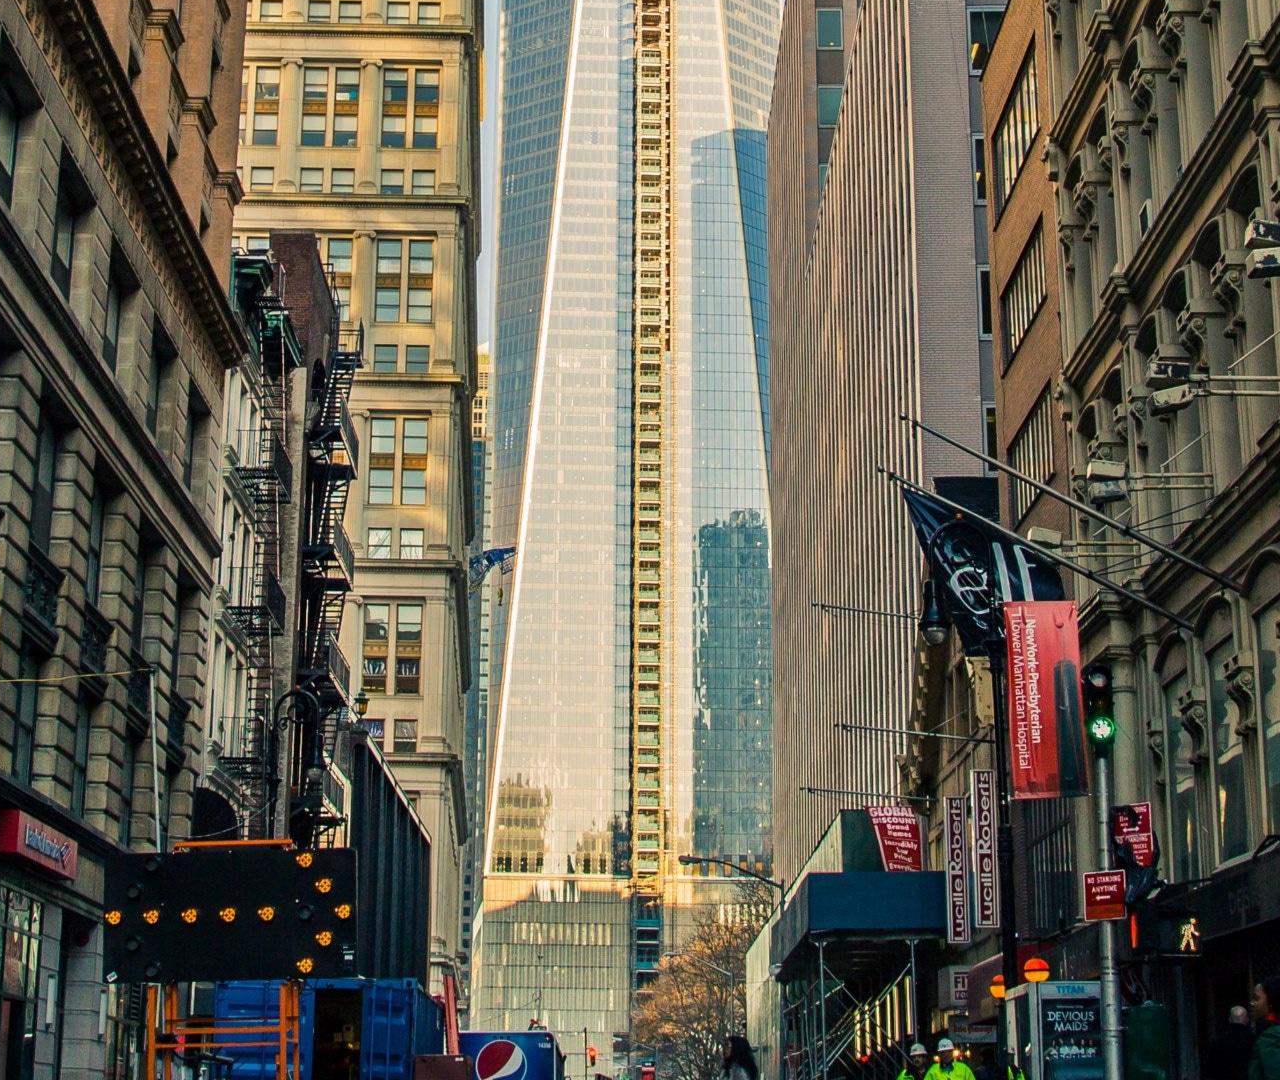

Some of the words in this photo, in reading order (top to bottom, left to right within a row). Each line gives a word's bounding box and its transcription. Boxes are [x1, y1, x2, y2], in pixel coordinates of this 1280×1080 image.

[1011, 620, 1021, 649] Lower
[1013, 653, 1027, 720] Manhattan
[1025, 619, 1041, 745] NewYork-Presbyterian
[1016, 721, 1032, 769] Hospital
[869, 806, 915, 818] GLOBAL
[872, 816, 916, 825] DISCOUNT
[976, 772, 991, 854] Roberts
[949, 799, 963, 875] Roberts
[980, 856, 993, 925] Lucille
[1087, 877, 1095, 885] NO
[1097, 874, 1121, 883] STANDING
[1091, 884, 1118, 893] ANYTIME
[953, 877, 964, 941] Lucille
[1056, 985, 1086, 994] TITAN
[1047, 1011, 1095, 1021] DEVIOUS
[1054, 1021, 1089, 1033] MAIDS
